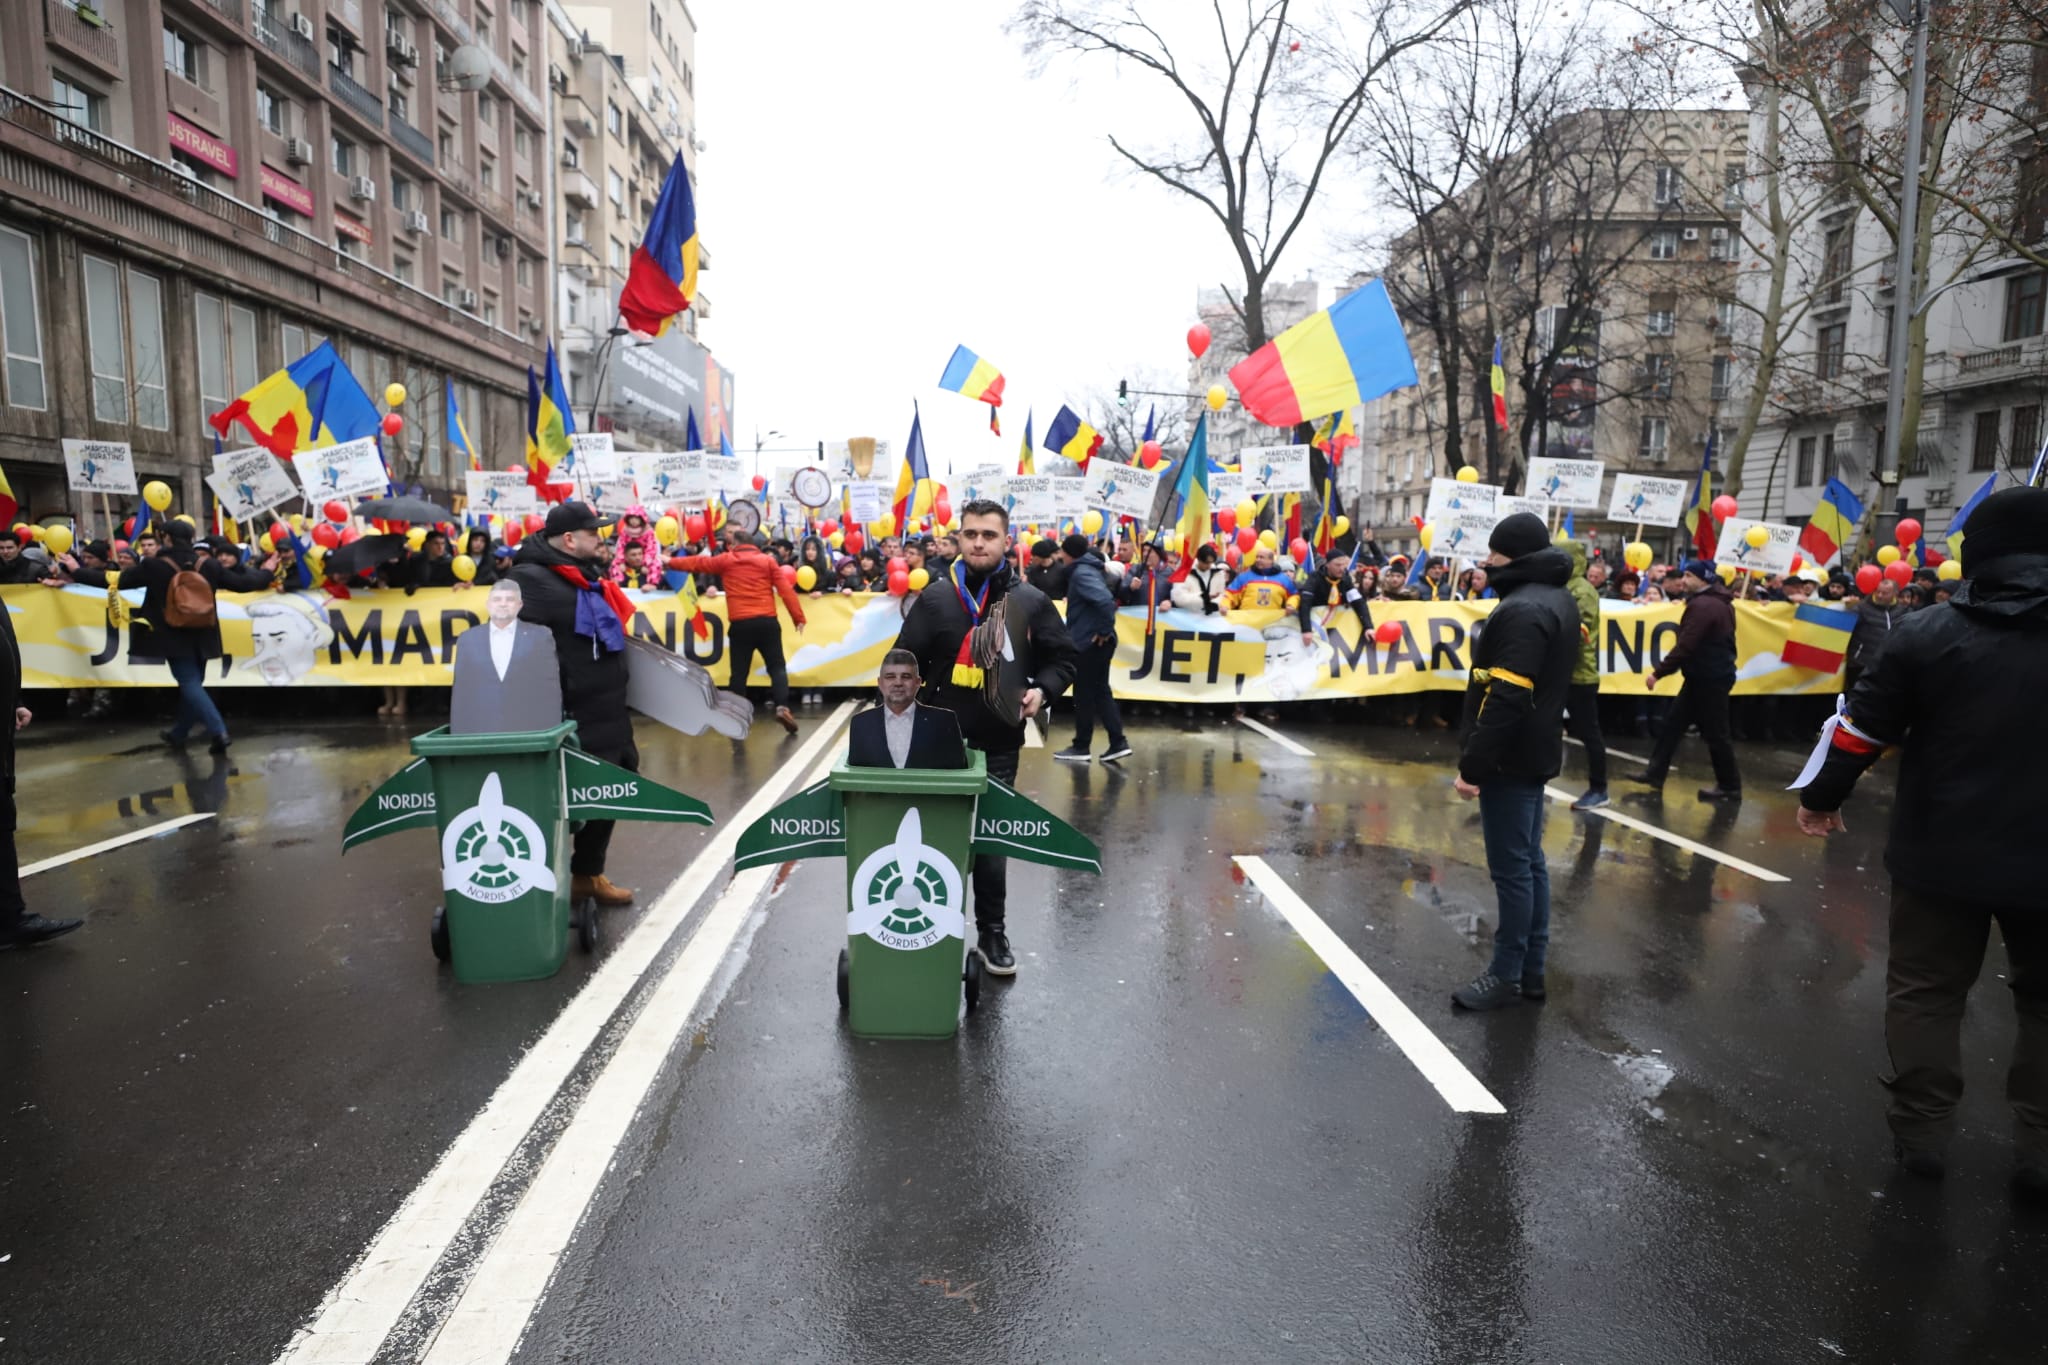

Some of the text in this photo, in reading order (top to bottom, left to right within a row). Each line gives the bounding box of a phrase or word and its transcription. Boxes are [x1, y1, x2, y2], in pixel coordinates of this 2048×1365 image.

[1007, 478, 1050, 486] MARCELINO
[1130, 629, 1245, 696] JET,
[378, 792, 436, 810] NORDIS
[571, 781, 639, 803] NORDIS
[770, 818, 841, 835] NORDIS
[980, 817, 1051, 837] NORDIS
[466, 883, 525, 902] NORDIS JET
[877, 930, 938, 949] NORDIS JET
